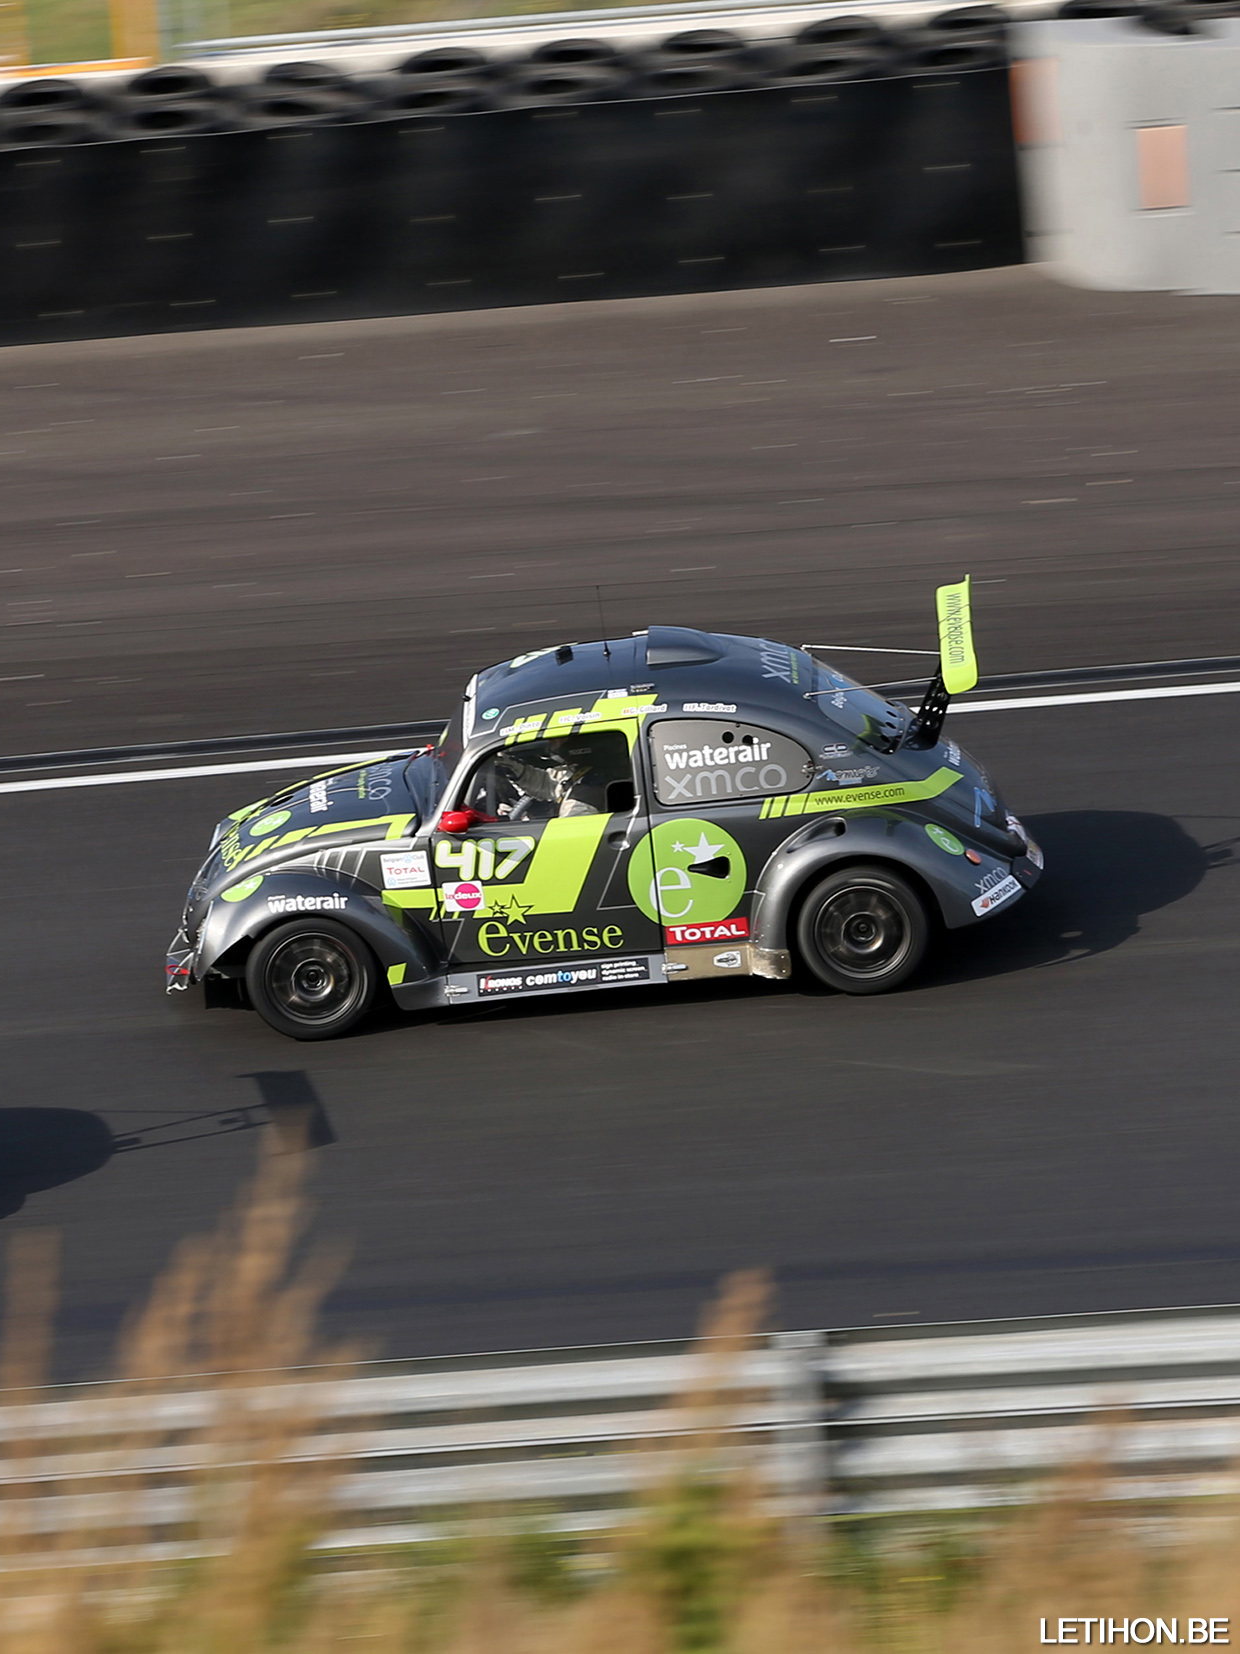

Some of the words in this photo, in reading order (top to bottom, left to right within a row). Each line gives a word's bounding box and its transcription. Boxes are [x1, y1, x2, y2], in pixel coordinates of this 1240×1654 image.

[664, 737, 772, 770] waterair
[664, 763, 788, 800] xmco
[814, 786, 906, 806] www.evense.com
[434, 836, 536, 881] 417
[386, 866, 426, 876] TOTAL
[268, 893, 348, 913] waterair
[477, 920, 624, 957] evense
[669, 924, 746, 943] TOTAL
[479, 974, 523, 991] KRONOS
[525, 967, 597, 988] comtoyou
